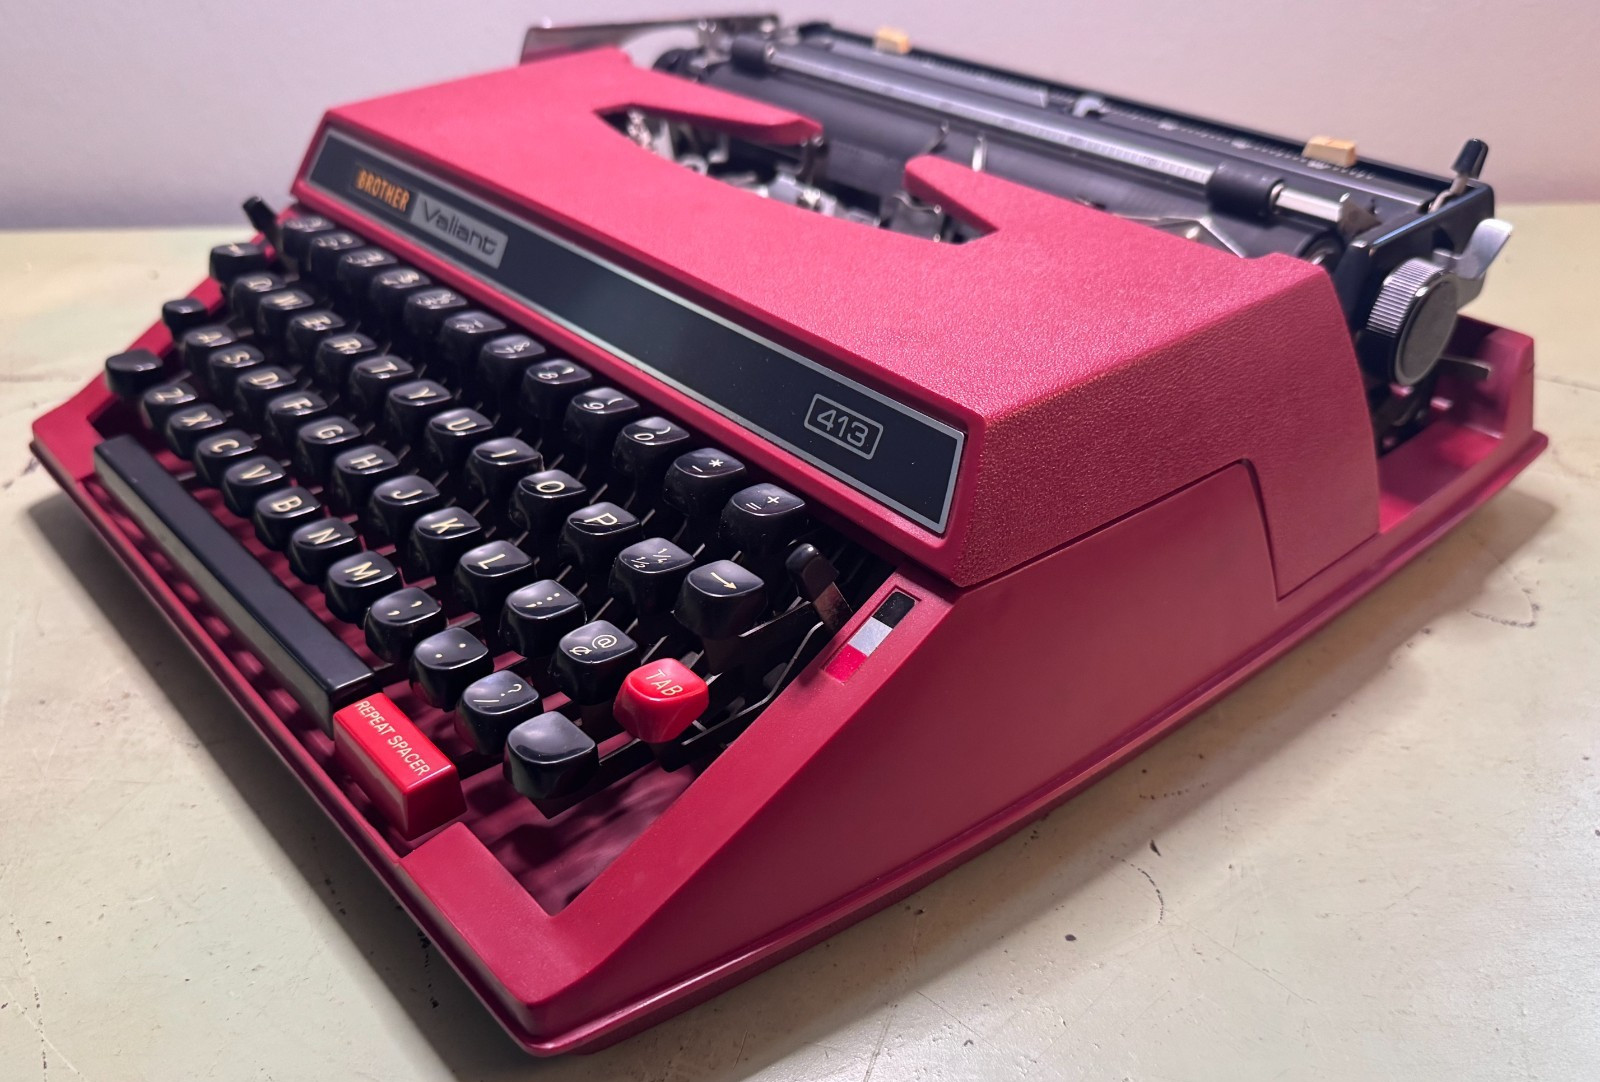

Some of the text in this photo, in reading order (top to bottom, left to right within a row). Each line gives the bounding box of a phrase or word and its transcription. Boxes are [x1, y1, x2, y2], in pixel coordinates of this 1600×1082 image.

[355, 167, 410, 213] BROTHER
[424, 200, 498, 256] Valiant
[332, 337, 363, 351] R
[370, 361, 398, 374] T
[250, 371, 279, 386] D
[407, 386, 437, 400] Y
[282, 397, 314, 410] F
[583, 402, 605, 410] 9
[179, 410, 213, 427] X
[446, 416, 478, 431] U
[315, 424, 345, 440] G
[816, 409, 869, 448] 413
[210, 438, 240, 453] C
[350, 452, 384, 470] H
[240, 463, 272, 480] V
[390, 489, 424, 500] J
[271, 495, 303, 513] B
[429, 517, 465, 535] K
[583, 512, 618, 526] P
[307, 527, 342, 545] N
[477, 553, 507, 570] L
[343, 561, 381, 582] M
[591, 634, 618, 650] @
[500, 683, 523, 697] ?
[645, 668, 685, 697] TAB
[354, 699, 431, 777] REPEAT SPACER
